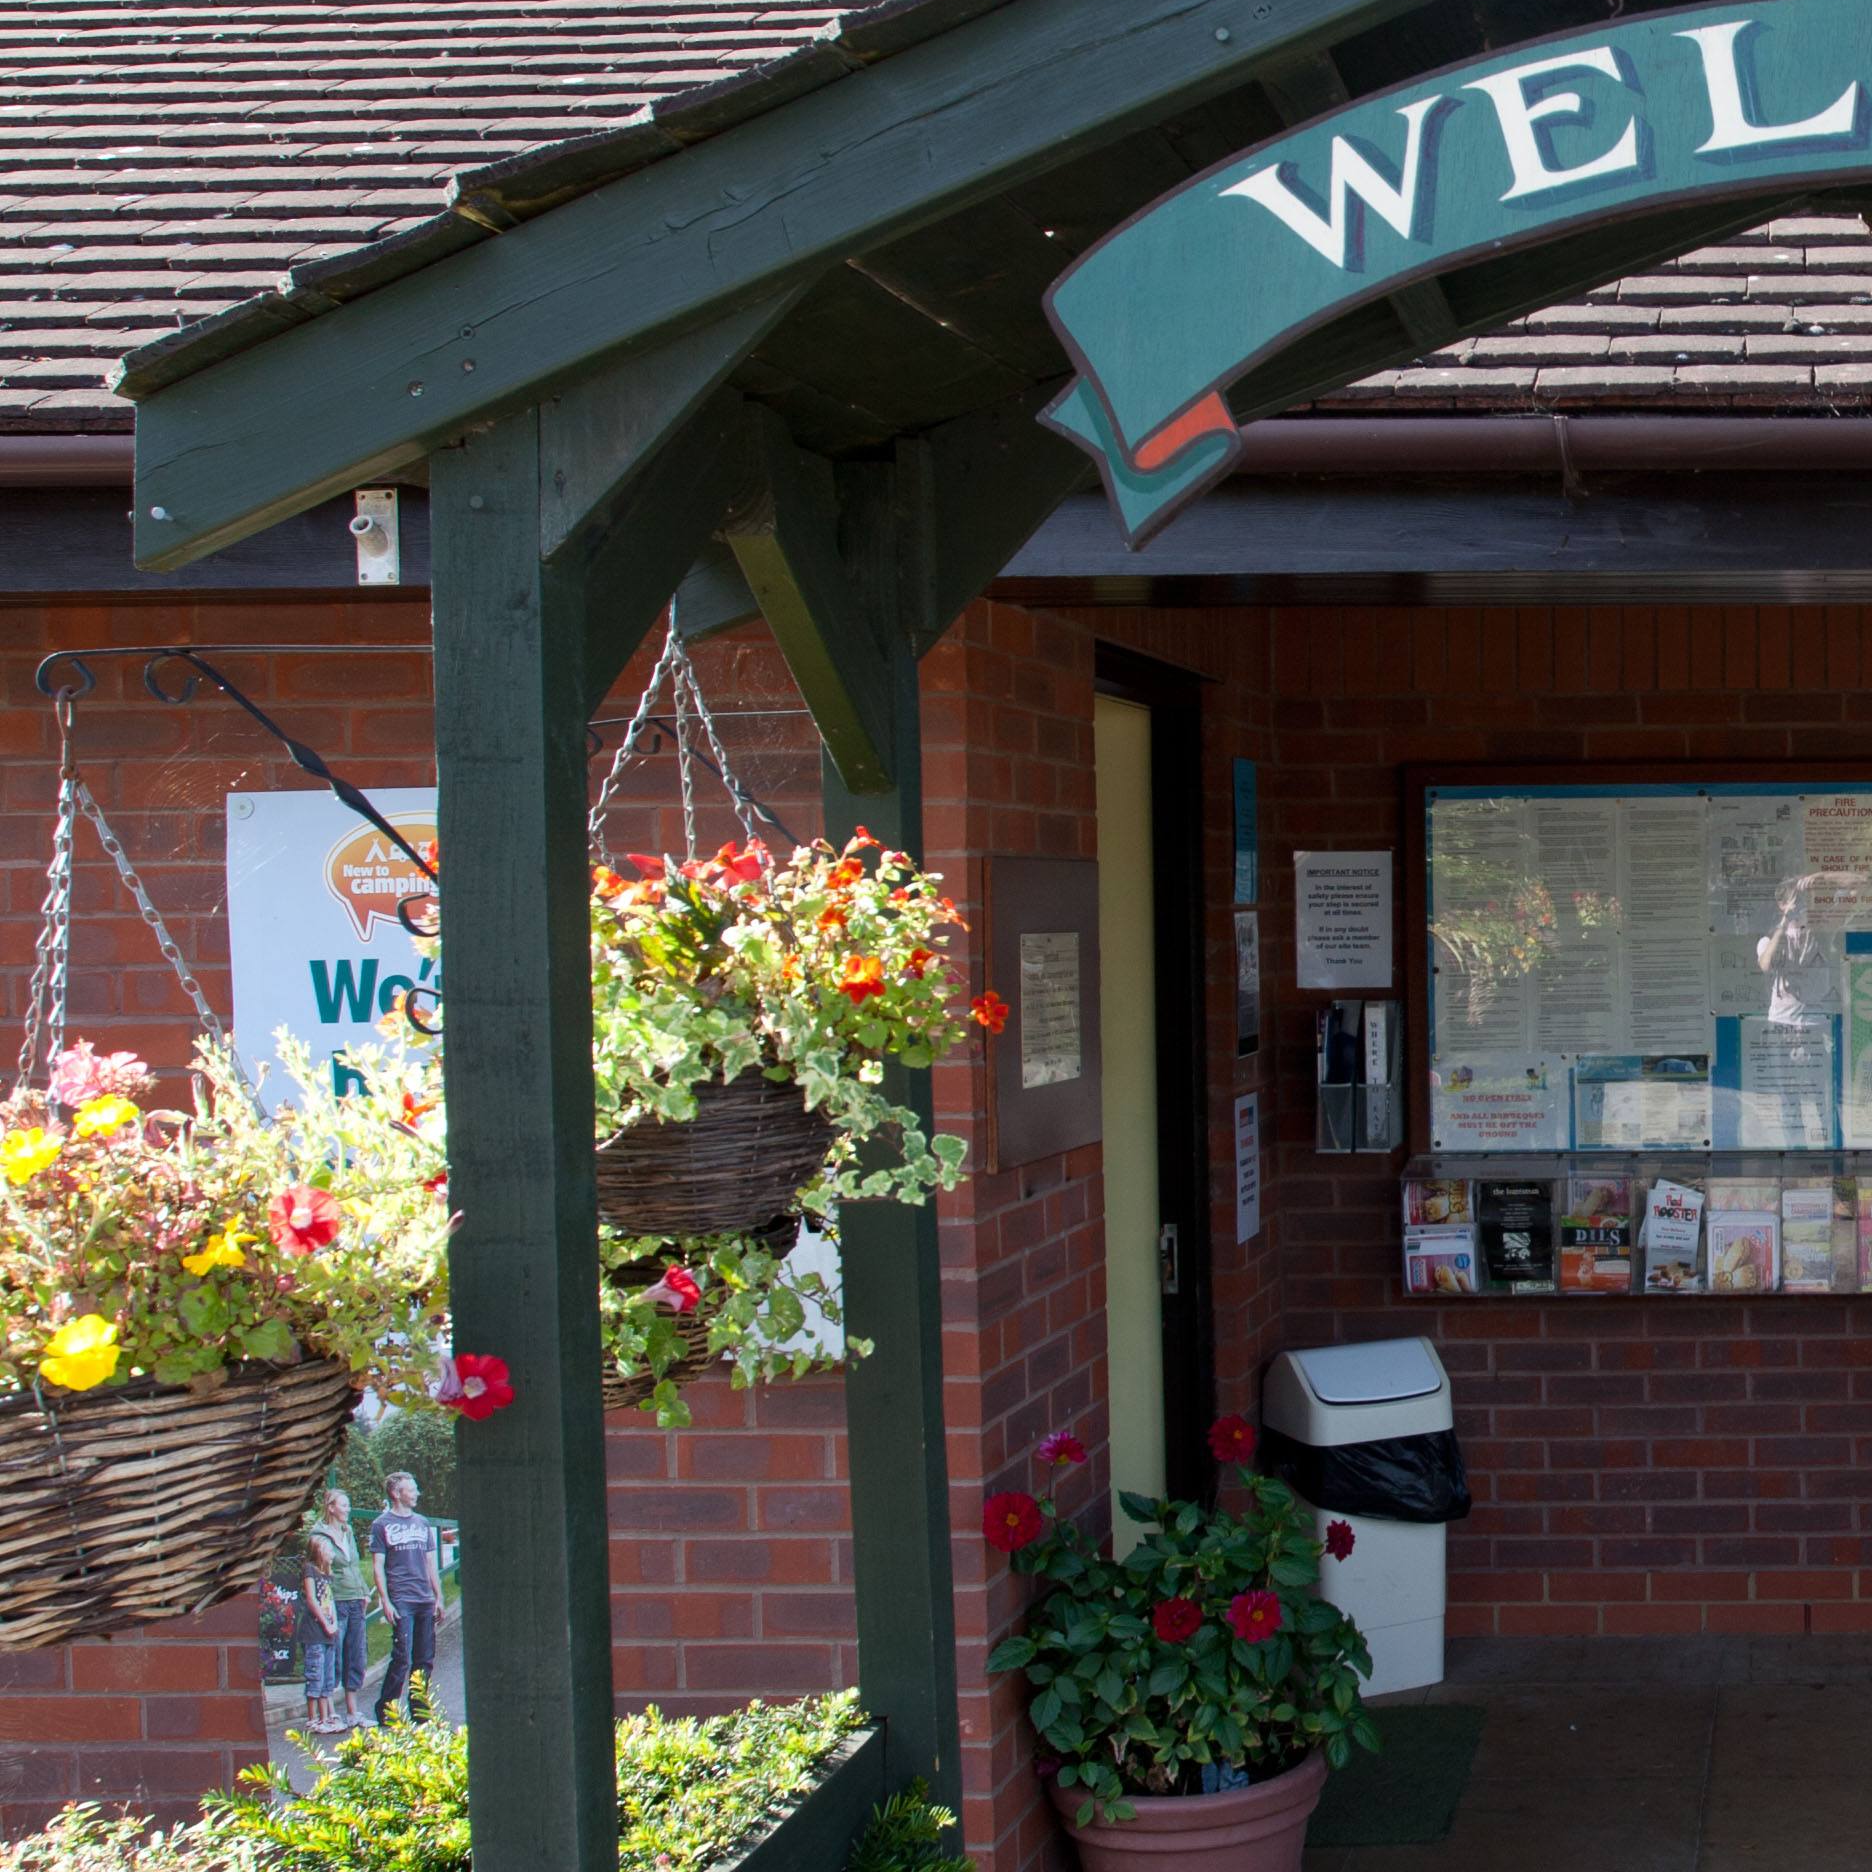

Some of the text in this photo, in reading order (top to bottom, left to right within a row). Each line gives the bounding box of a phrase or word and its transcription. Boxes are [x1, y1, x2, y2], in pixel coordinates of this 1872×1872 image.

[1835, 798, 1857, 807] FIRE
[343, 864, 389, 878] New to
[1814, 896, 1857, 904] SHOUTING
[1369, 1021, 1378, 1066] WHERE
[1653, 1205, 1697, 1221] ROOSTER
